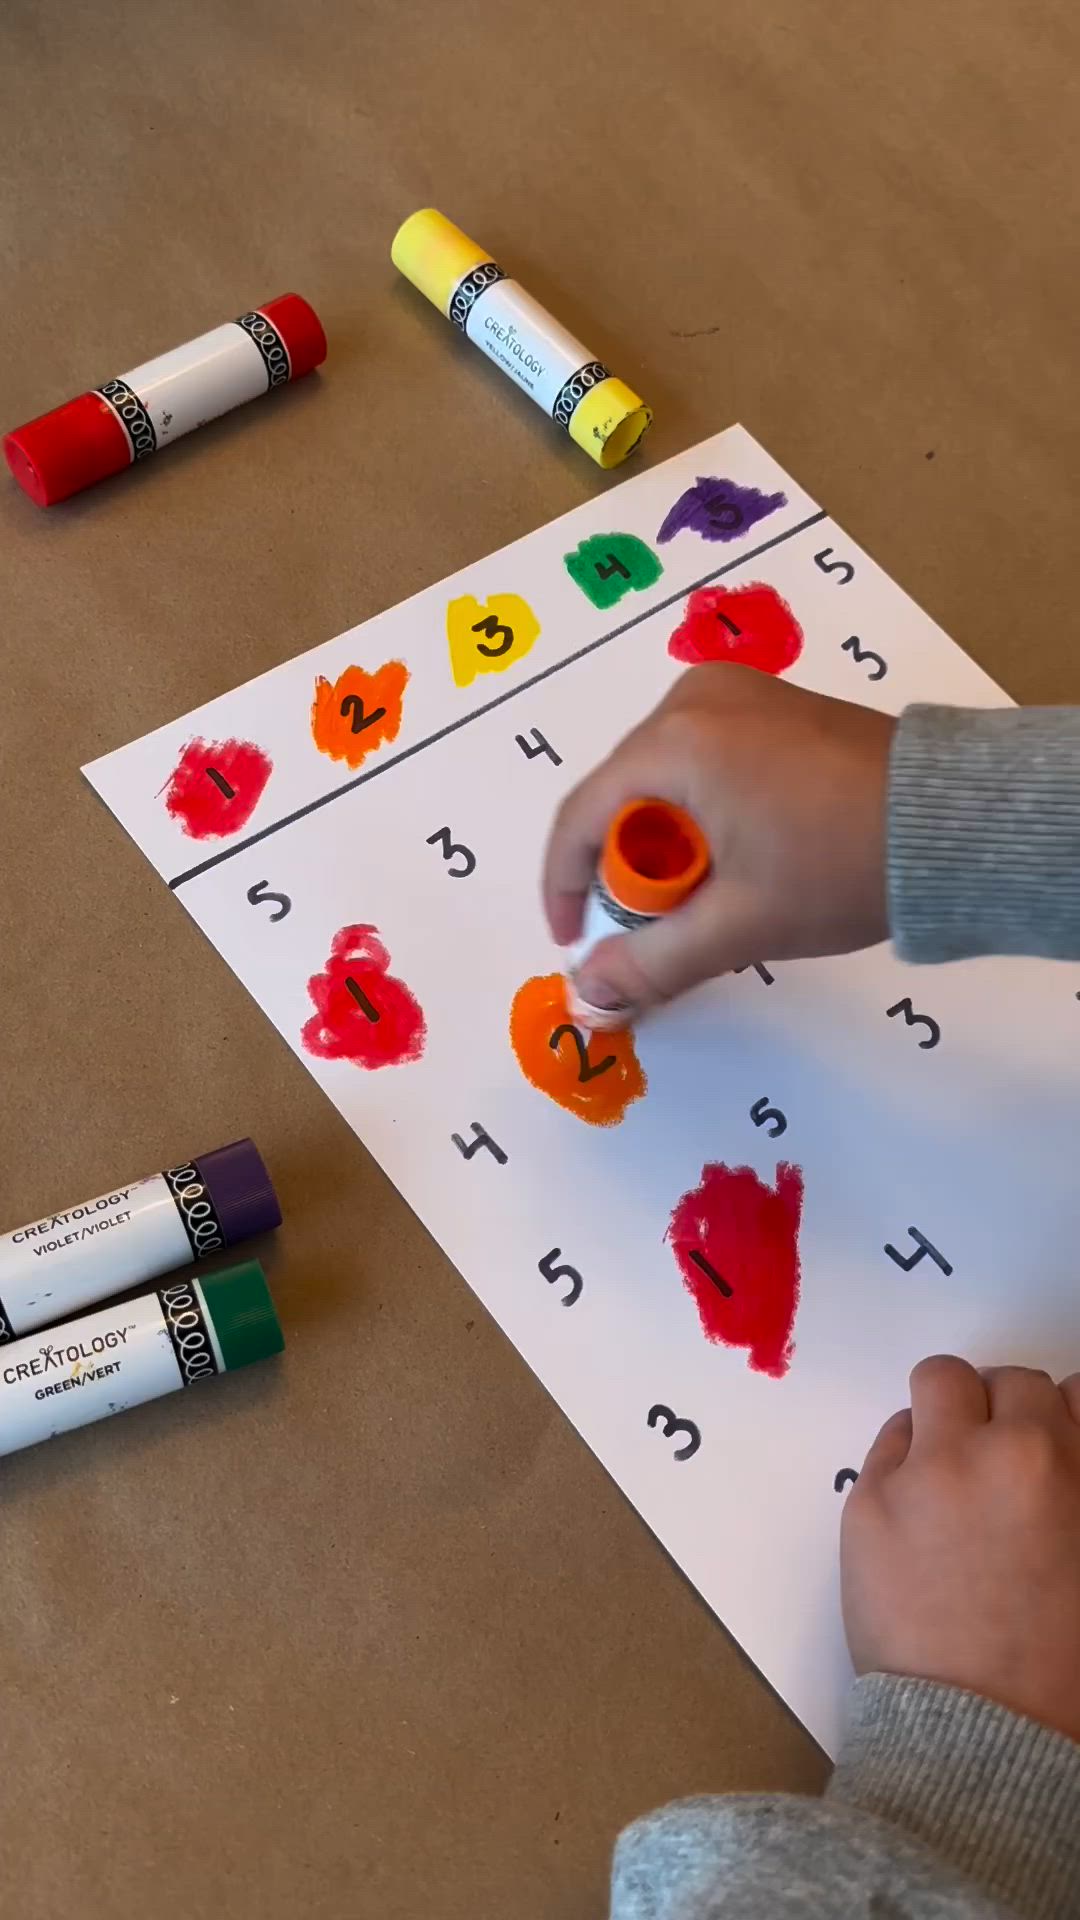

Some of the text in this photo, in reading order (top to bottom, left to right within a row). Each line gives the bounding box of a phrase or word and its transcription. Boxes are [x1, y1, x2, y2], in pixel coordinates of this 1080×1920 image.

[813, 547, 855, 585] 5
[206, 494, 743, 799] 1 2 3 4 5
[716, 612, 742, 636] 1
[841, 635, 888, 681] 3
[515, 727, 563, 766] 4
[426, 826, 477, 878] 3
[246, 879, 292, 923] 5
[345, 976, 380, 1023] 1
[886, 998, 941, 1049] 3
[549, 1024, 617, 1083] 2
[749, 1096, 787, 1138] 5
[451, 1121, 508, 1165] 4
[688, 1249, 733, 1298] 1
[884, 1226, 953, 1276] 4
[538, 1247, 584, 1307] 5
[35, 1361, 122, 1400] GREEN/VERT
[646, 1403, 701, 1461] 3
